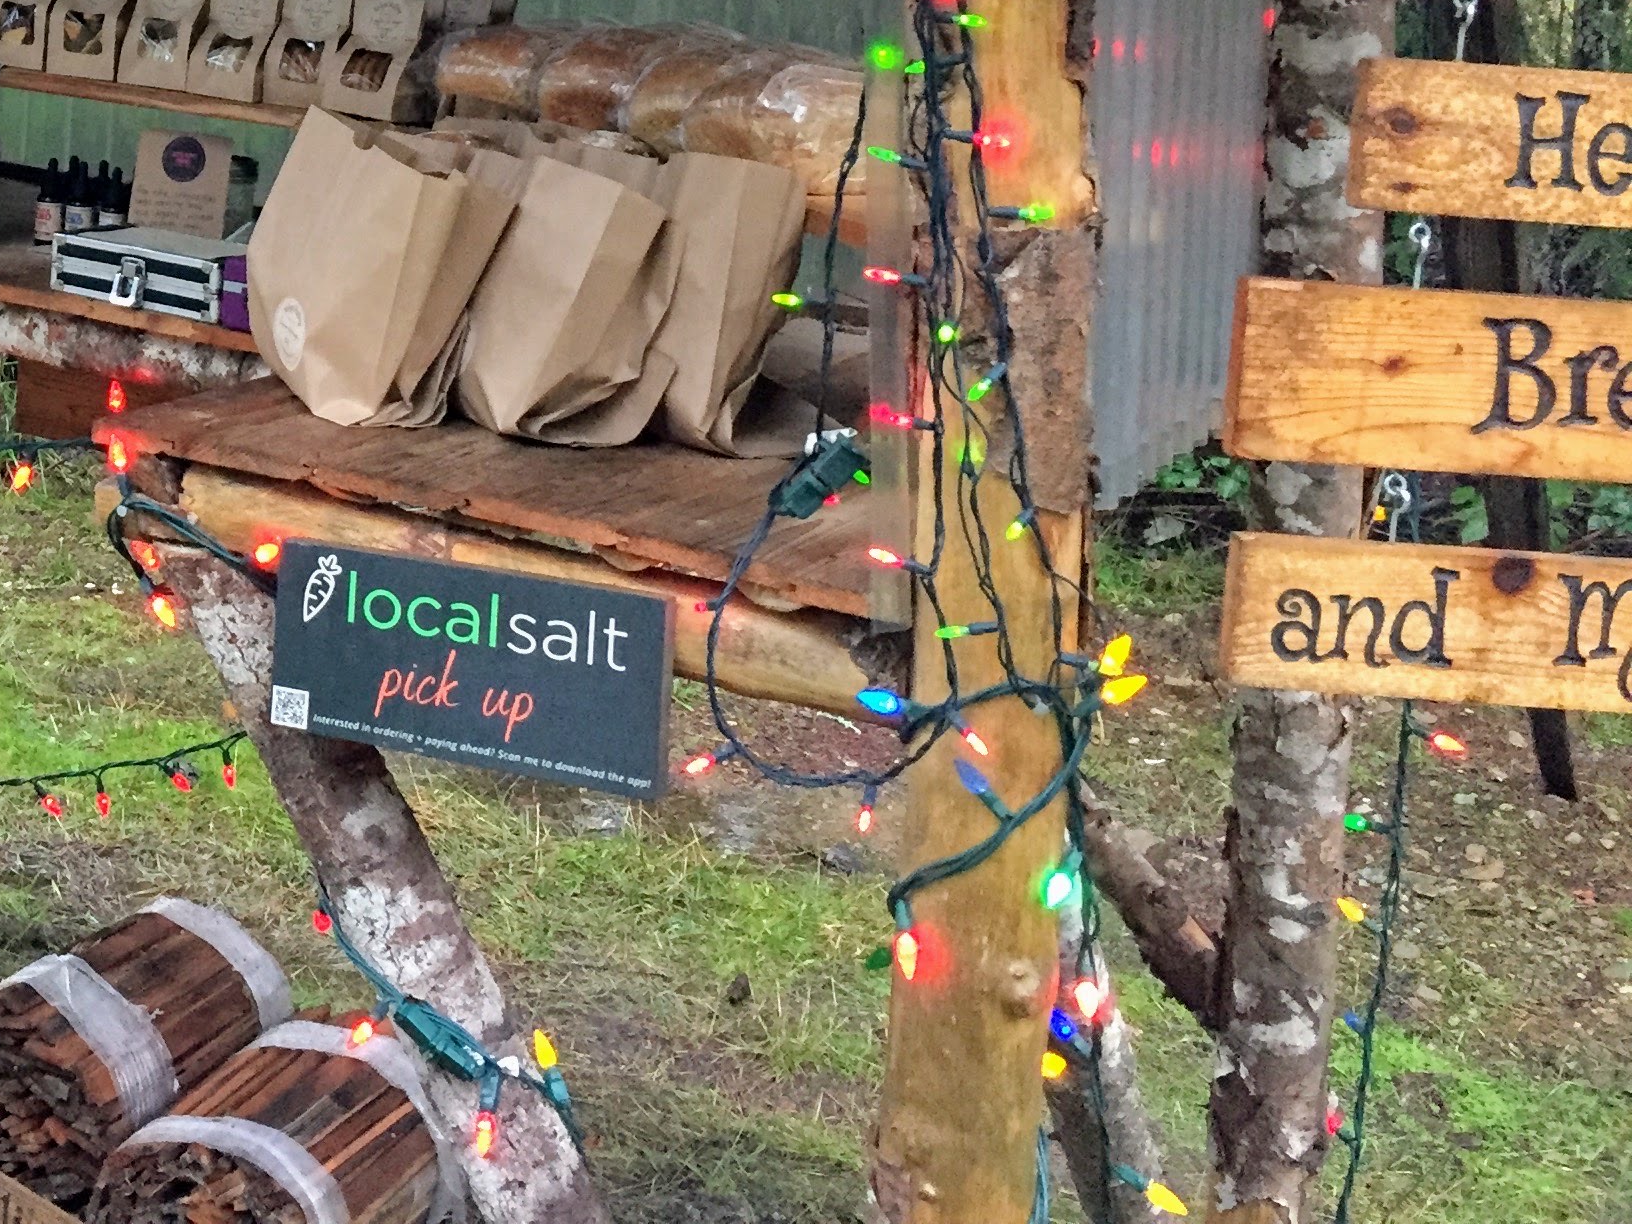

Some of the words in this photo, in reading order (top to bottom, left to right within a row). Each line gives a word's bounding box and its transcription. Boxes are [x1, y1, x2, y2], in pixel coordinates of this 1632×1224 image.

[1504, 89, 1632, 196] He
[347, 569, 629, 672] localsalt
[1270, 565, 1460, 668] and
[373, 648, 462, 718] pick
[481, 685, 535, 743] up
[313, 713, 360, 730] Interested
[361, 721, 371, 733] in
[373, 726, 414, 744] ordering
[424, 737, 458, 752] paying
[459, 742, 495, 757] ahead?
[497, 749, 521, 762] Scan
[523, 755, 539, 767] me
[541, 758, 553, 769] to
[555, 761, 606, 779] download
[607, 771, 625, 783] the
[627, 777, 652, 789] app!
